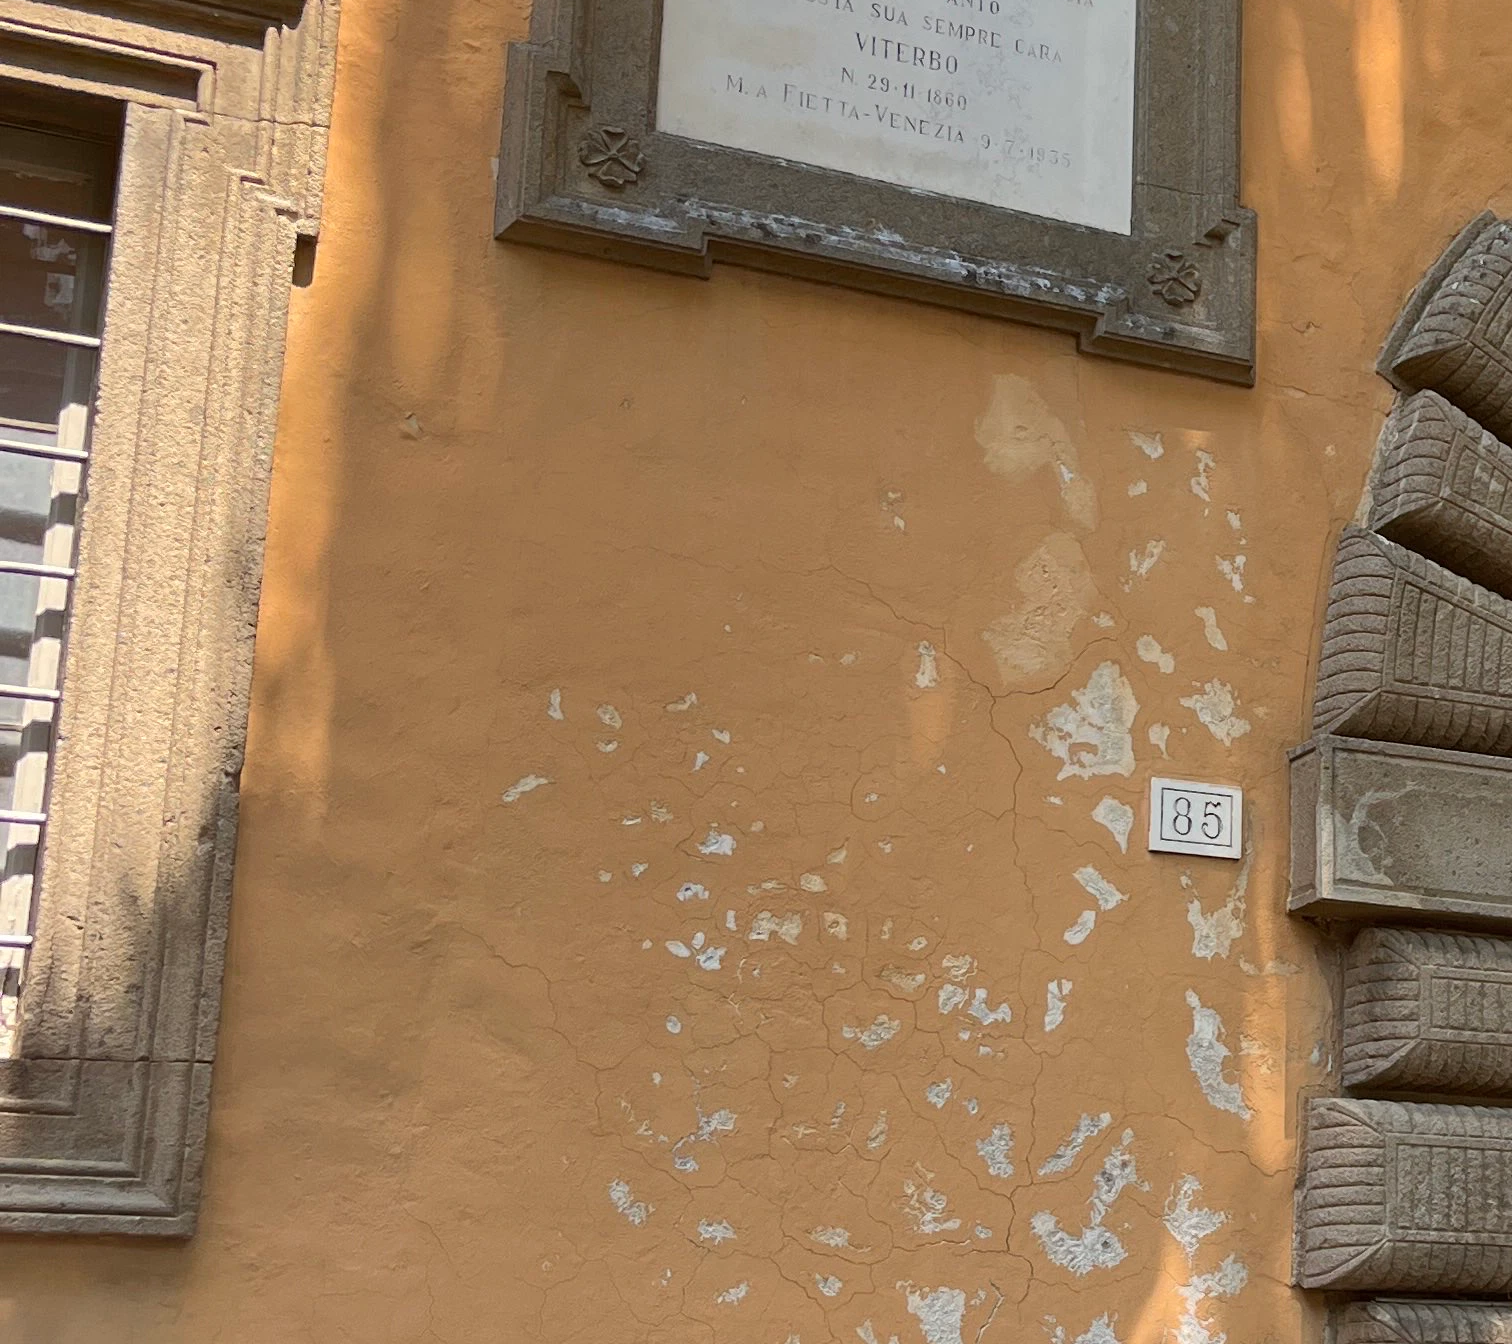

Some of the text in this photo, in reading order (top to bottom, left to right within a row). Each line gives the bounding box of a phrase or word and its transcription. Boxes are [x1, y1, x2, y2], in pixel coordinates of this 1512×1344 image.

[855, 31, 959, 75] VITERBO
[870, 2, 909, 27] SUA
[921, 15, 1002, 49] SEMPRE
[1014, 38, 1063, 64] CARA
[1173, 796, 1224, 840] 85
